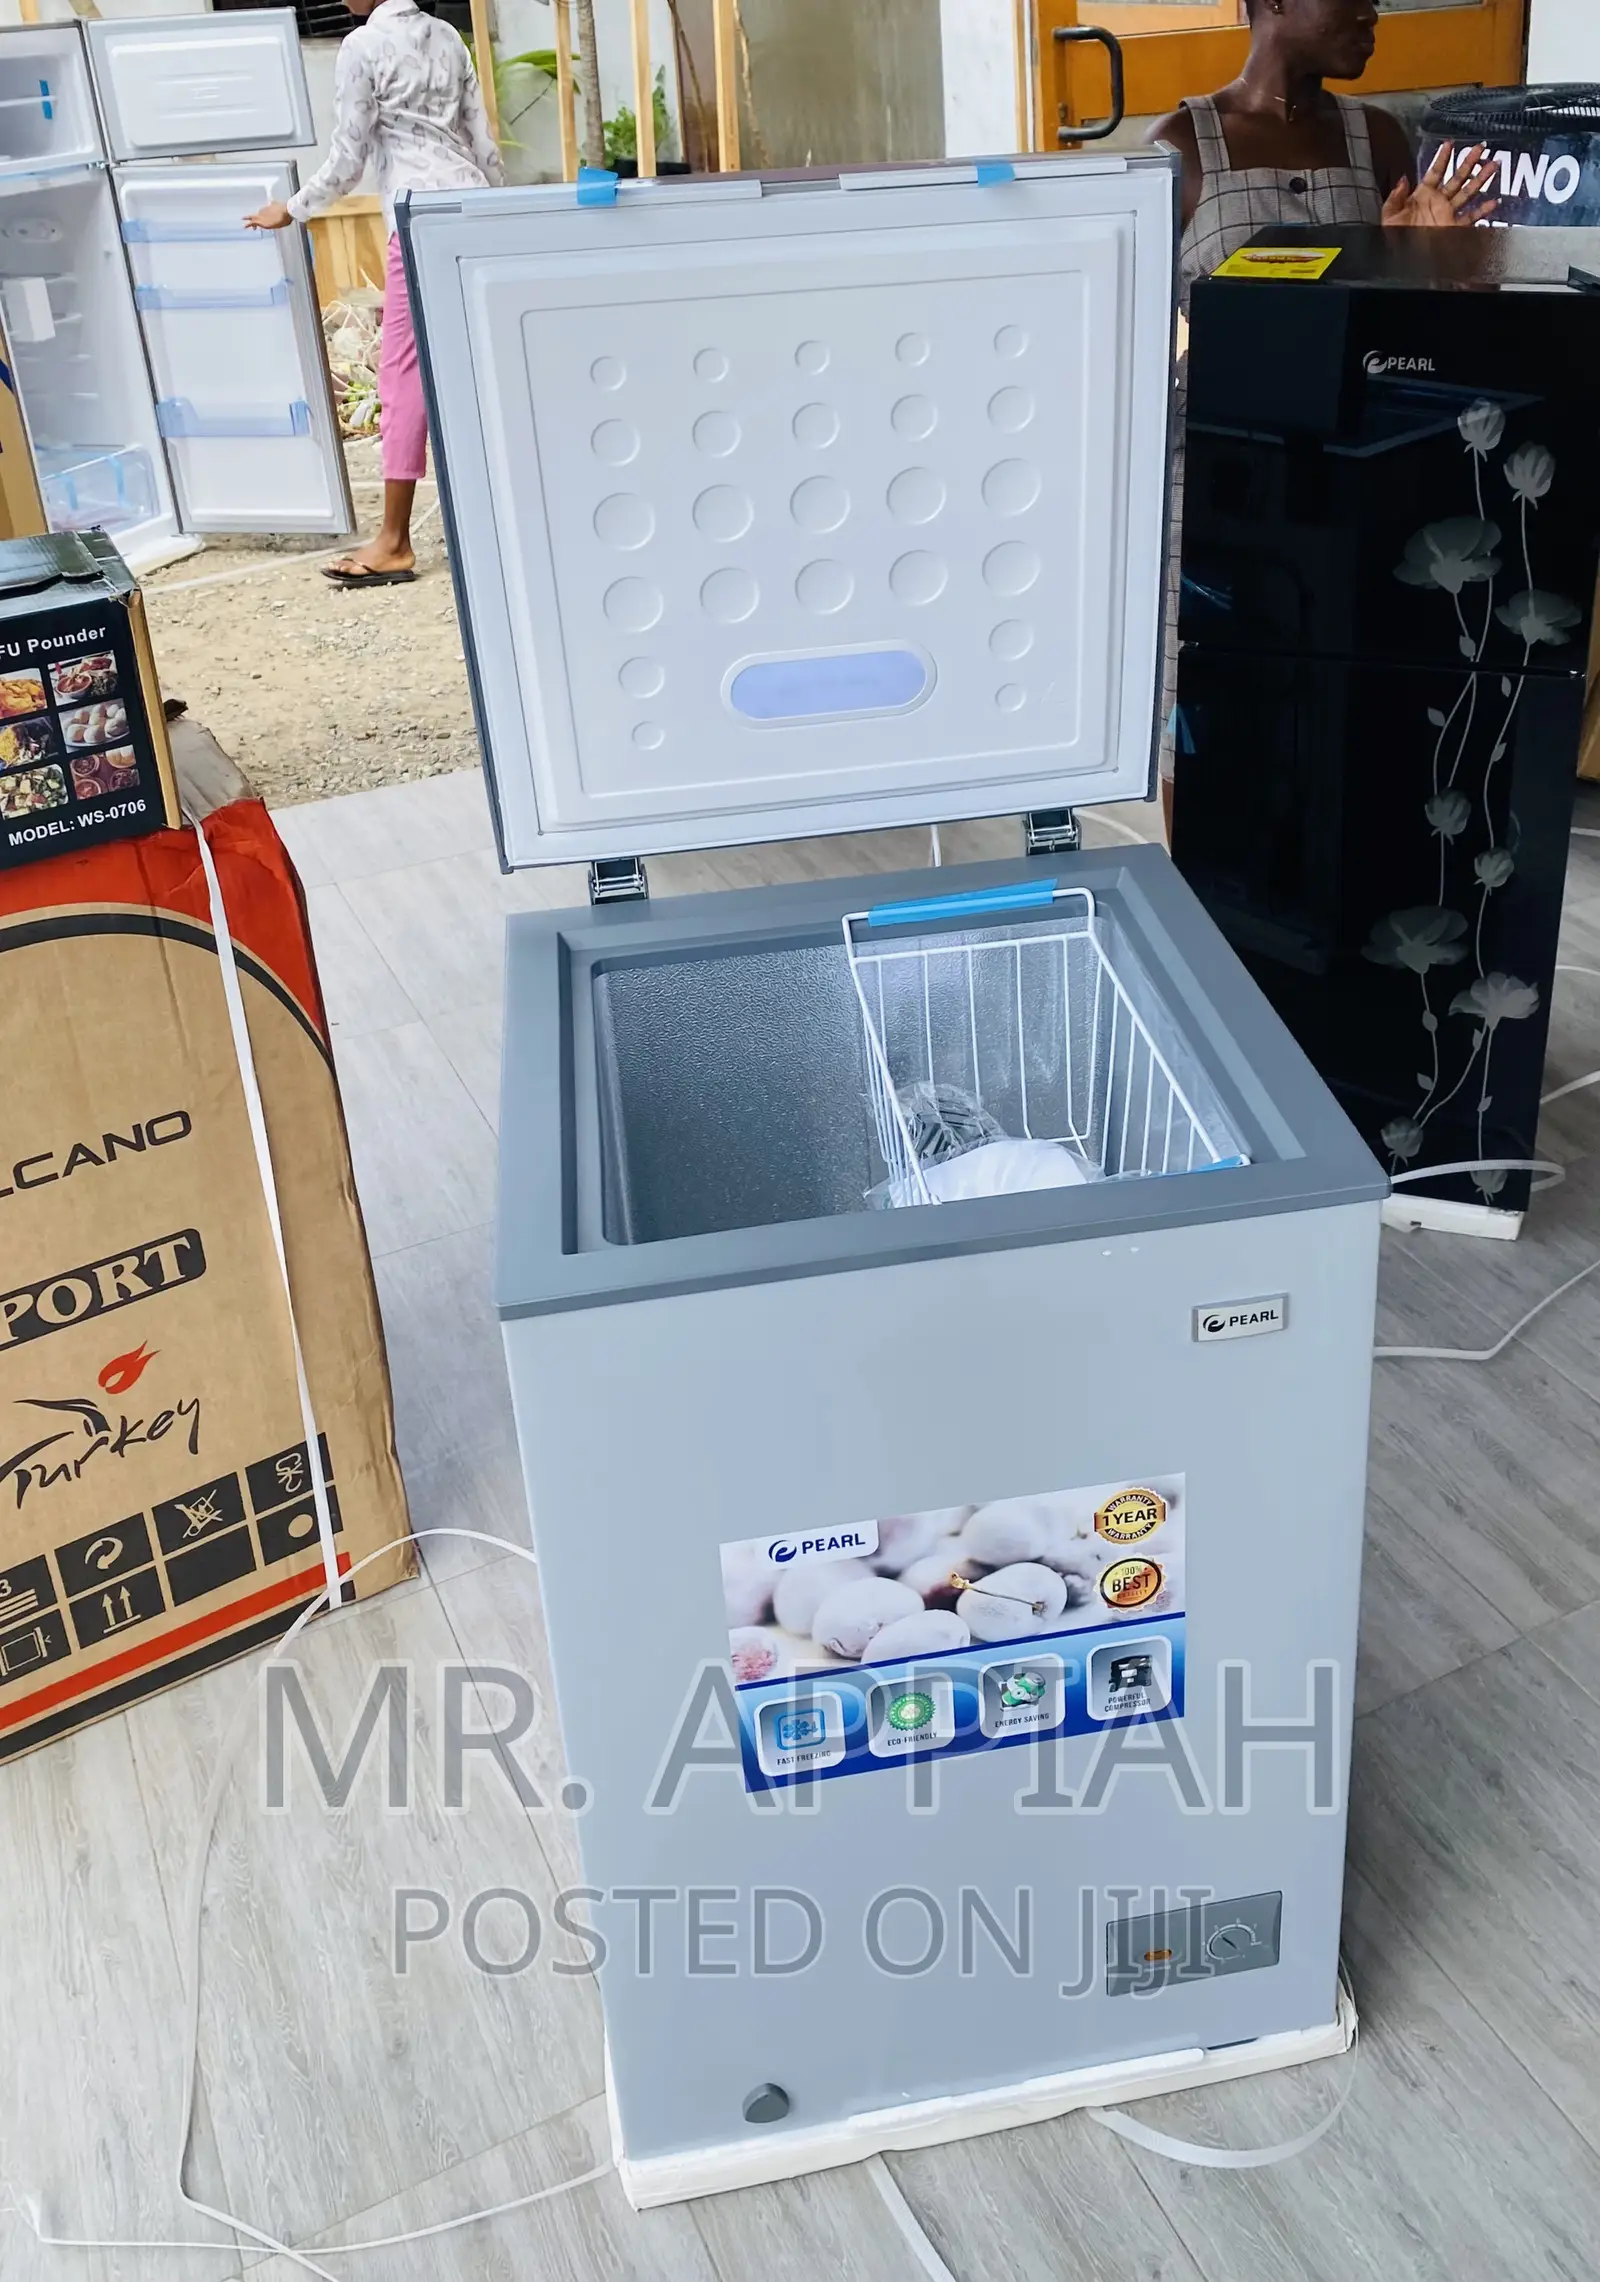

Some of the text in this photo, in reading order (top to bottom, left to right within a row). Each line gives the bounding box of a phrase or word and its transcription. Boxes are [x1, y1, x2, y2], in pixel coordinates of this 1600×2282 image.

[1387, 357, 1436, 372] PEARL
[27, 627, 106, 653] Pounder
[8, 799, 147, 846] MODEL: WS-0706
[0, 1236, 192, 1344] PORT
[1229, 1310, 1279, 1327] PEARL
[1108, 1494, 1153, 1512] WARRANTY
[1102, 1508, 1157, 1526] 1 YEAR
[1108, 1523, 1153, 1540] WARRANTY
[802, 1533, 866, 1554] PEARL
[1112, 1573, 1151, 1593] BEST
[1108, 1692, 1146, 1704] POWERFUL
[1024, 1713, 1050, 1723] SAVING
[777, 1751, 831, 1765] FAST FREEZING
